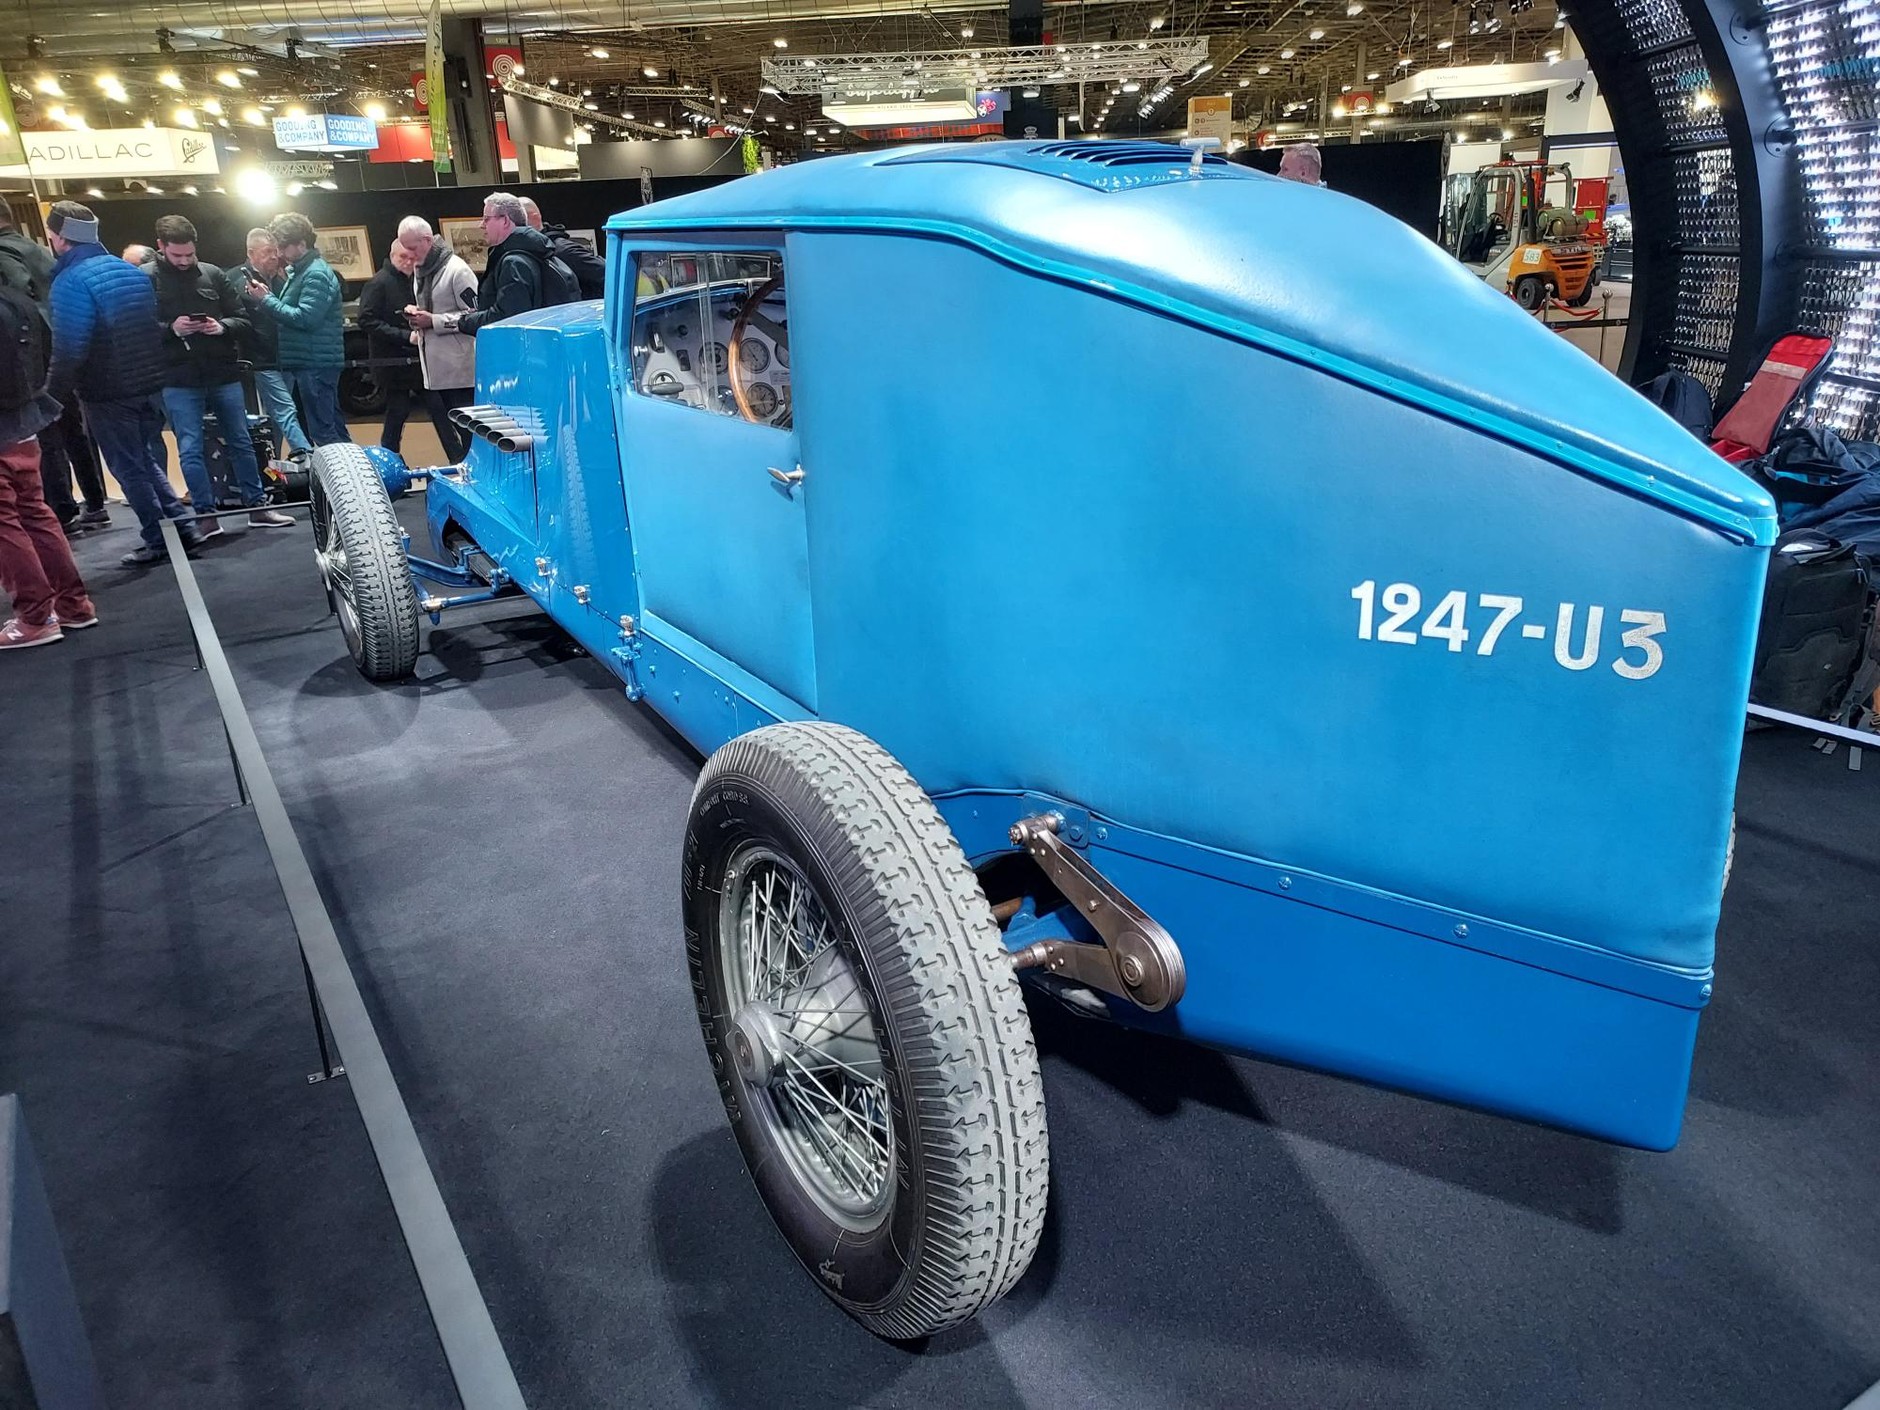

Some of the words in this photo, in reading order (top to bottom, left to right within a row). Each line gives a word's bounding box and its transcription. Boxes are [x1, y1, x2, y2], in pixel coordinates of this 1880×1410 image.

[276, 119, 317, 132] GOODG
[328, 118, 367, 131] GOODING
[29, 143, 153, 161] ADILLAC
[684, 925, 742, 1125] MICHELIN
